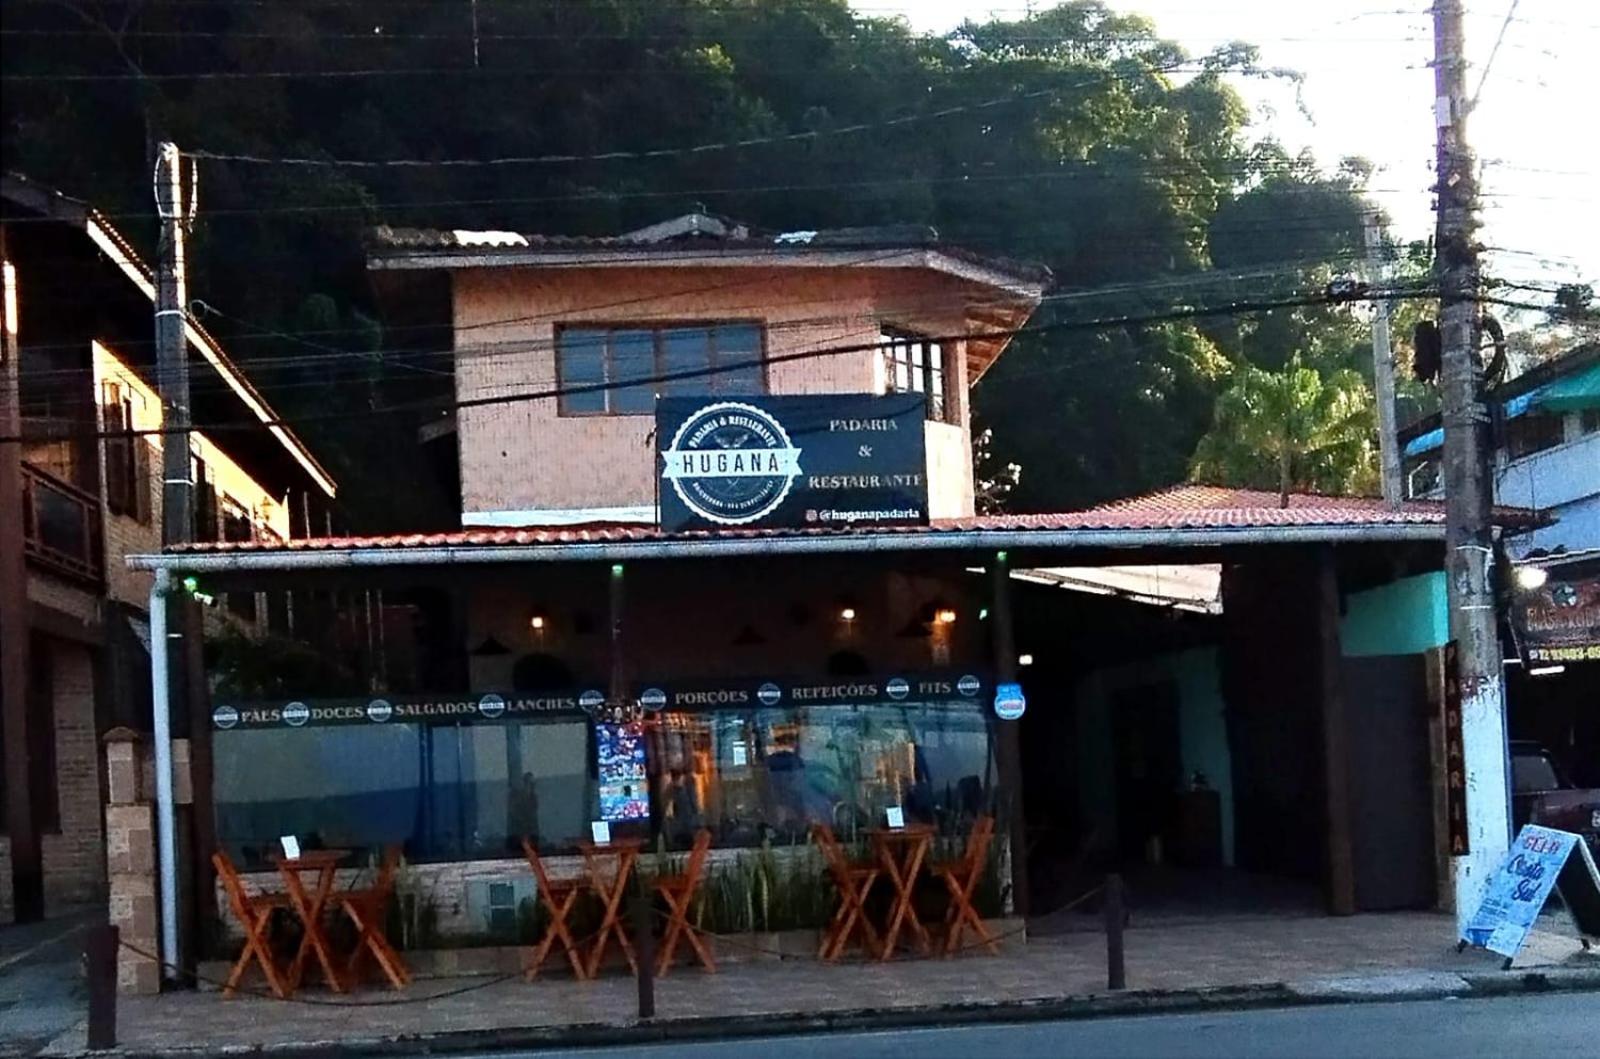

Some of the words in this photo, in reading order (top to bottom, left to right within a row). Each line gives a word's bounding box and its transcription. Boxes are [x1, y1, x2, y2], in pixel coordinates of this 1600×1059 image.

[829, 418, 898, 432] PADARIA
[858, 444, 873, 457] &
[682, 453, 779, 474] HUGANA
[809, 473, 921, 489] RESTAURANTE
[819, 508, 920, 522] @huganapadaria
[395, 702, 476, 716] SALGADOS
[507, 698, 575, 712] LANCHES
[312, 706, 364, 720] DOCES
[1447, 646, 1463, 852] PADARIA
